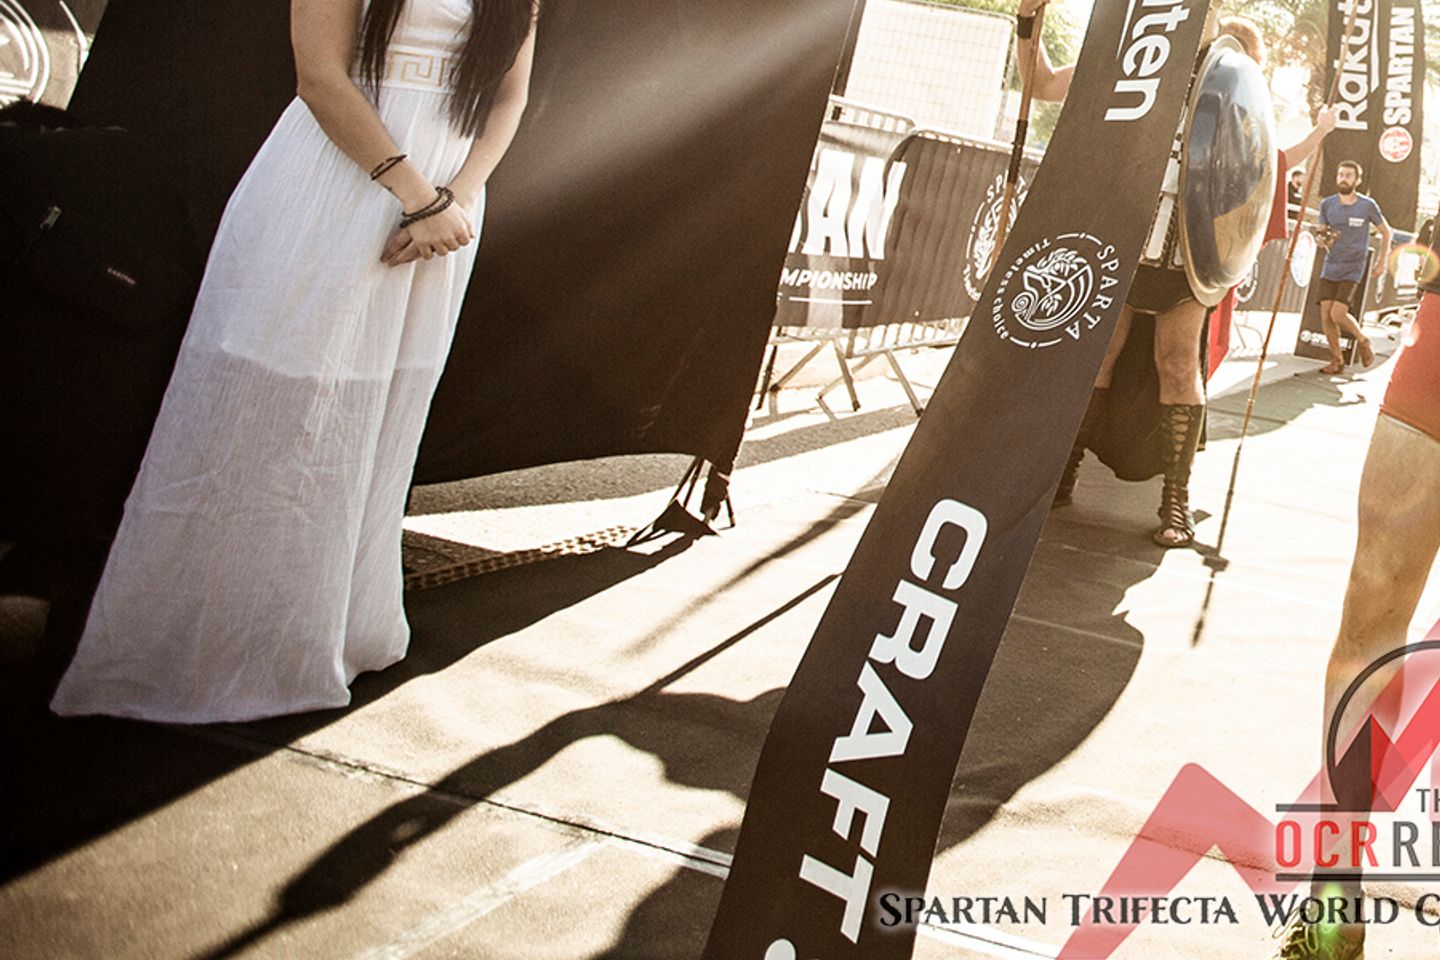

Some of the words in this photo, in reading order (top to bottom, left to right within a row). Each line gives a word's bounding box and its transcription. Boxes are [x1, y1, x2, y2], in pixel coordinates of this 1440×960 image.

[1383, 6, 1415, 126] SPARTAN
[780, 267, 879, 290] MPIONSHIP
[996, 238, 1052, 294] Timeless
[1065, 244, 1120, 340] SPARTA
[992, 297, 1010, 340] choice
[800, 498, 988, 944] CRAFT
